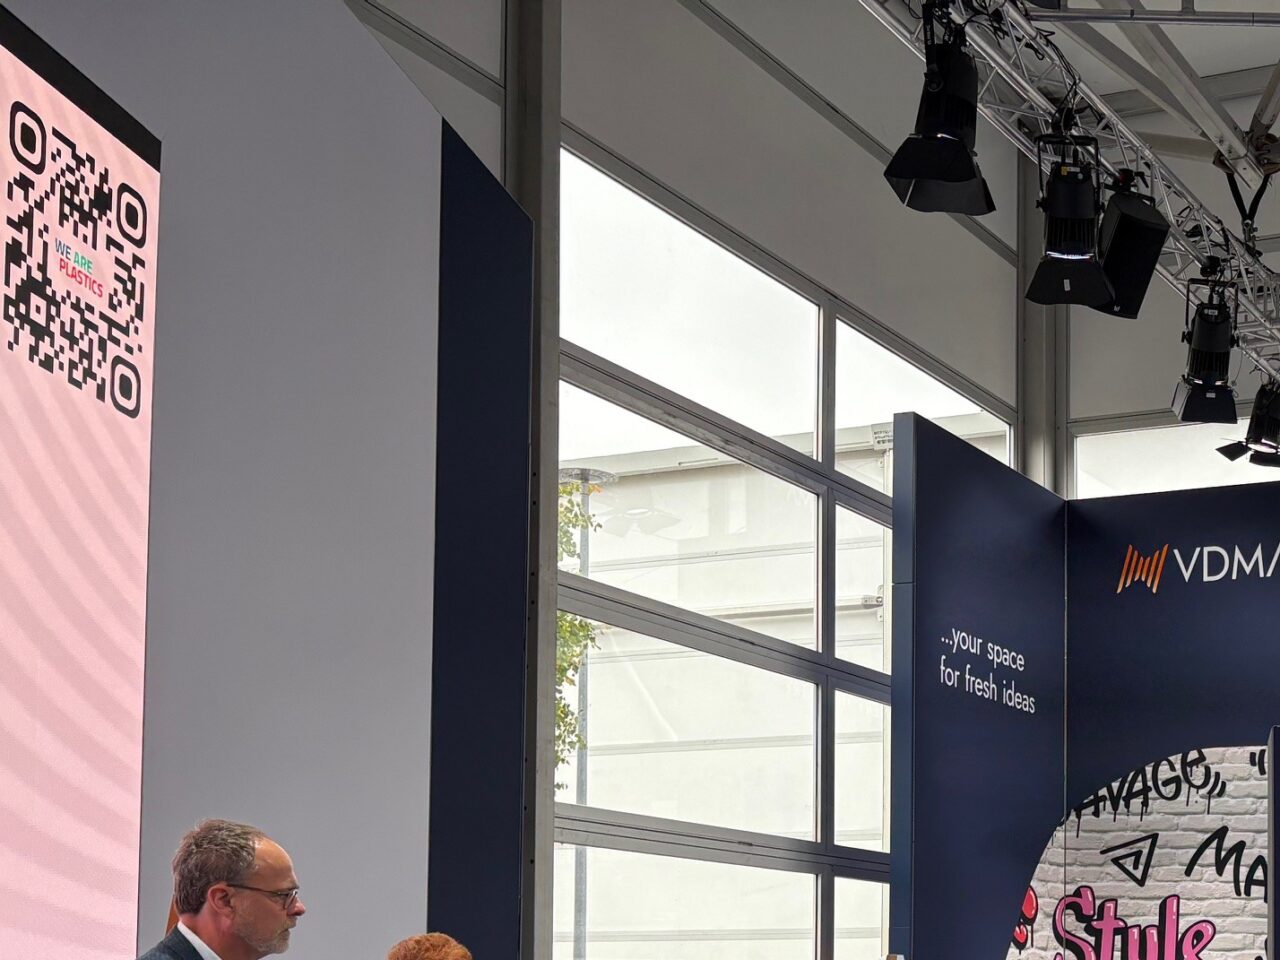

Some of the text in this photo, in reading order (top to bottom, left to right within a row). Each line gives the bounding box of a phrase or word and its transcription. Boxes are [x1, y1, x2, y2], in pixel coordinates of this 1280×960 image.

[55, 238, 93, 275] WE ARE
[59, 258, 104, 298] PLASTICS
[987, 642, 1025, 671] space
[940, 655, 1035, 714] for fresh ideas
